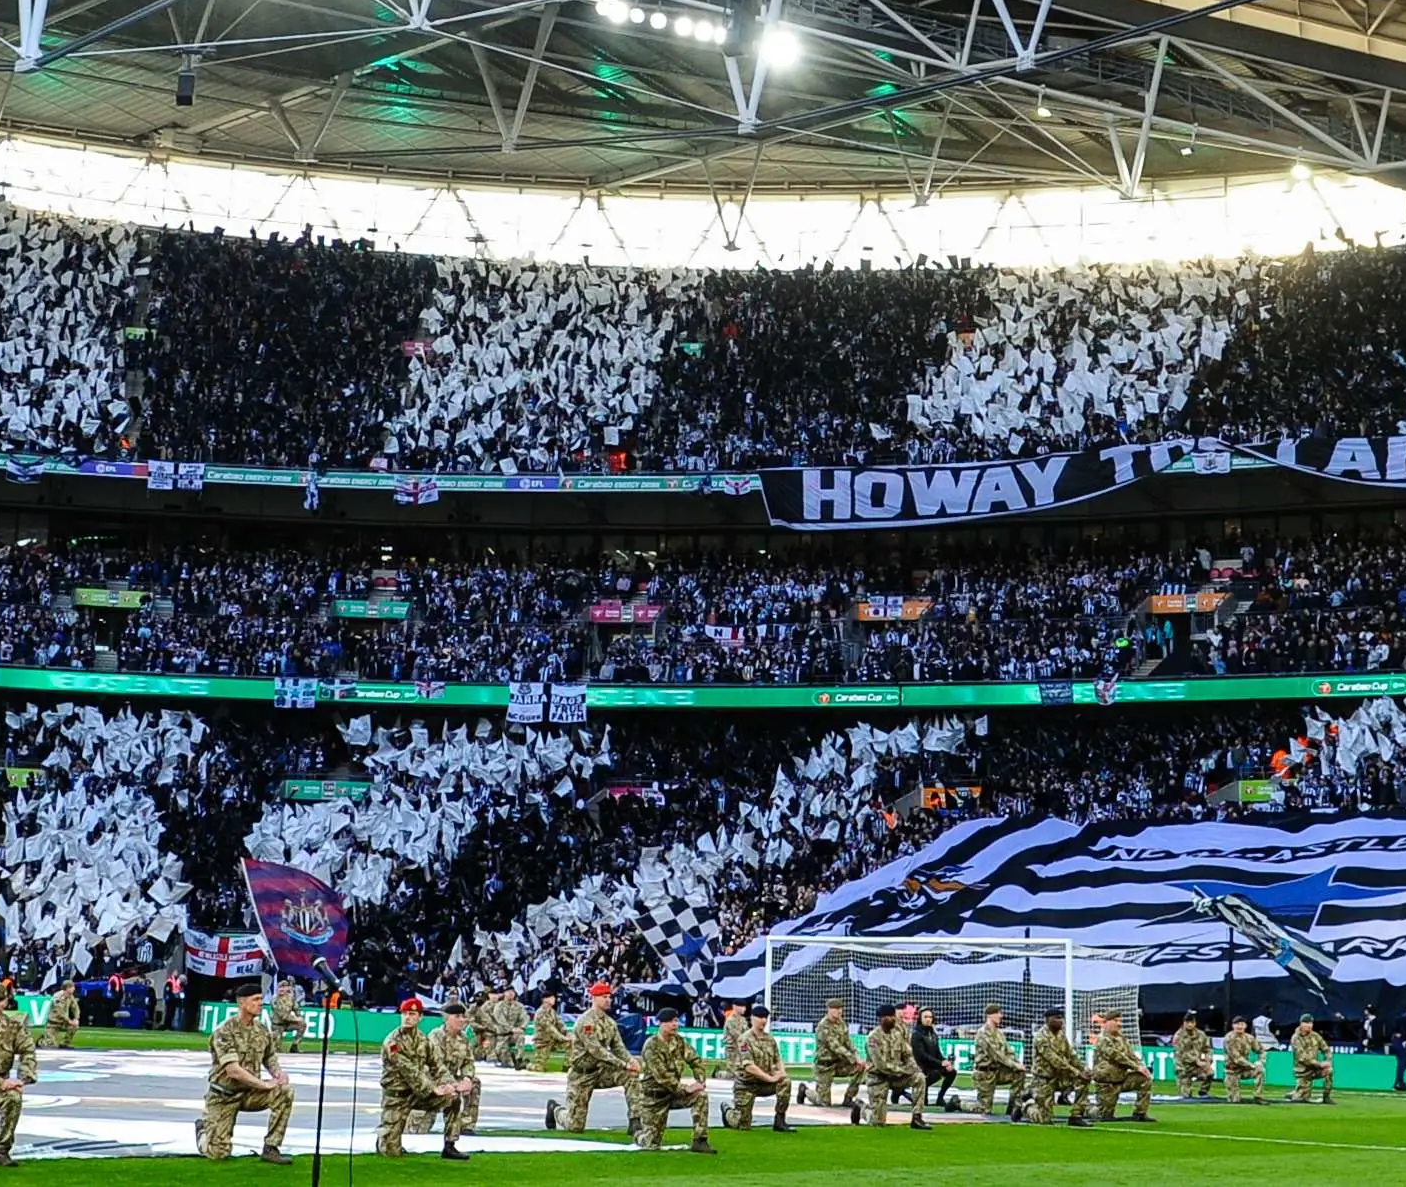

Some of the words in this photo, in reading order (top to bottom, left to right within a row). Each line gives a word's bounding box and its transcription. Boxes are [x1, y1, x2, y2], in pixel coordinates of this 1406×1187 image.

[206, 470, 244, 482] Carabao
[531, 480, 545, 488] EFL
[577, 480, 614, 489] Carabao
[802, 456, 1071, 521] HOWAY
